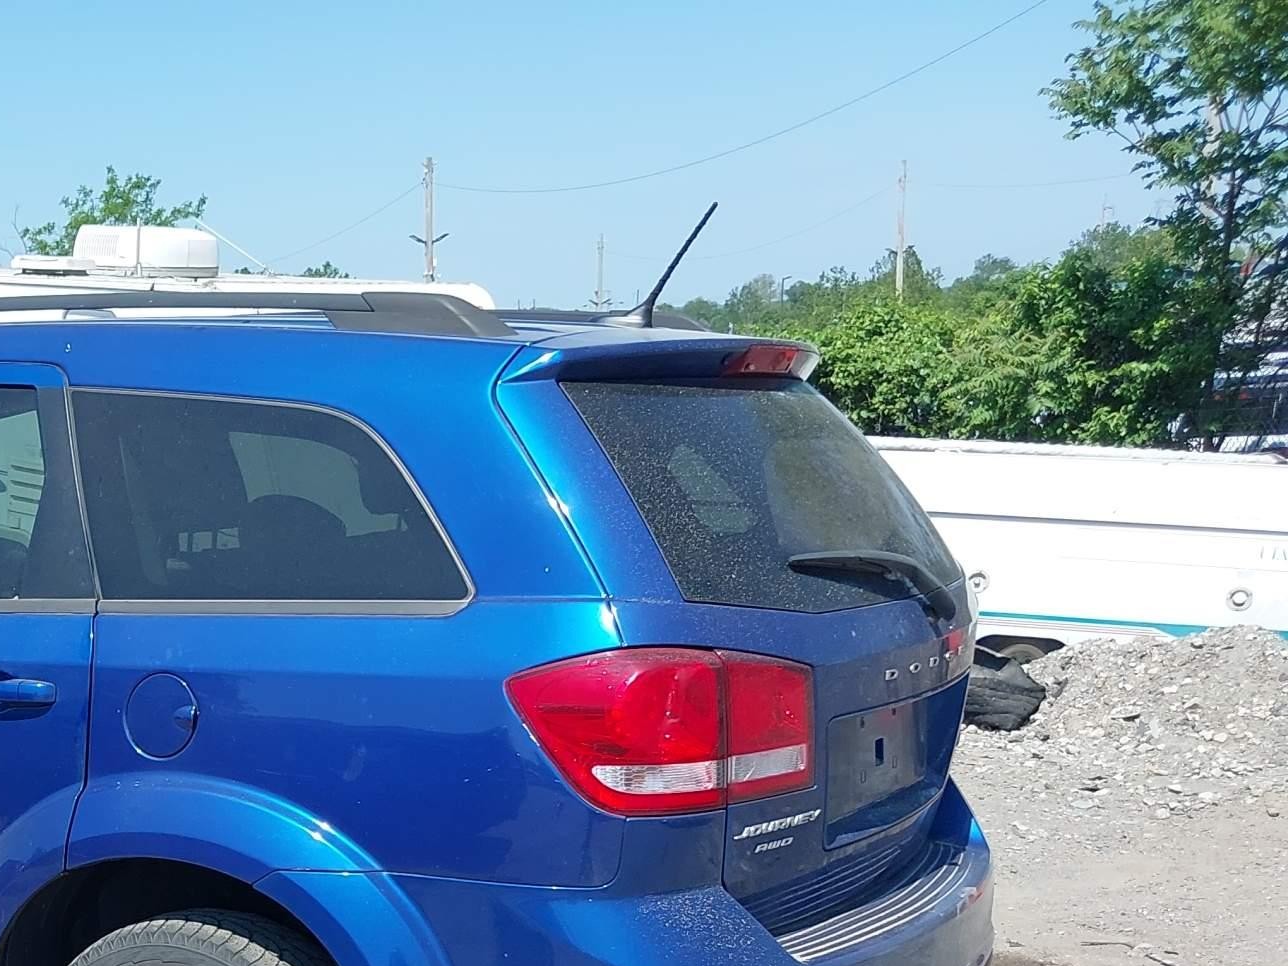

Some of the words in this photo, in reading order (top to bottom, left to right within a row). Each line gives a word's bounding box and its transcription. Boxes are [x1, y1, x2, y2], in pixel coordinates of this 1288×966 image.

[885, 644, 965, 681] DODGE
[733, 808, 822, 840] JOURNEY
[754, 836, 794, 853] AWD
